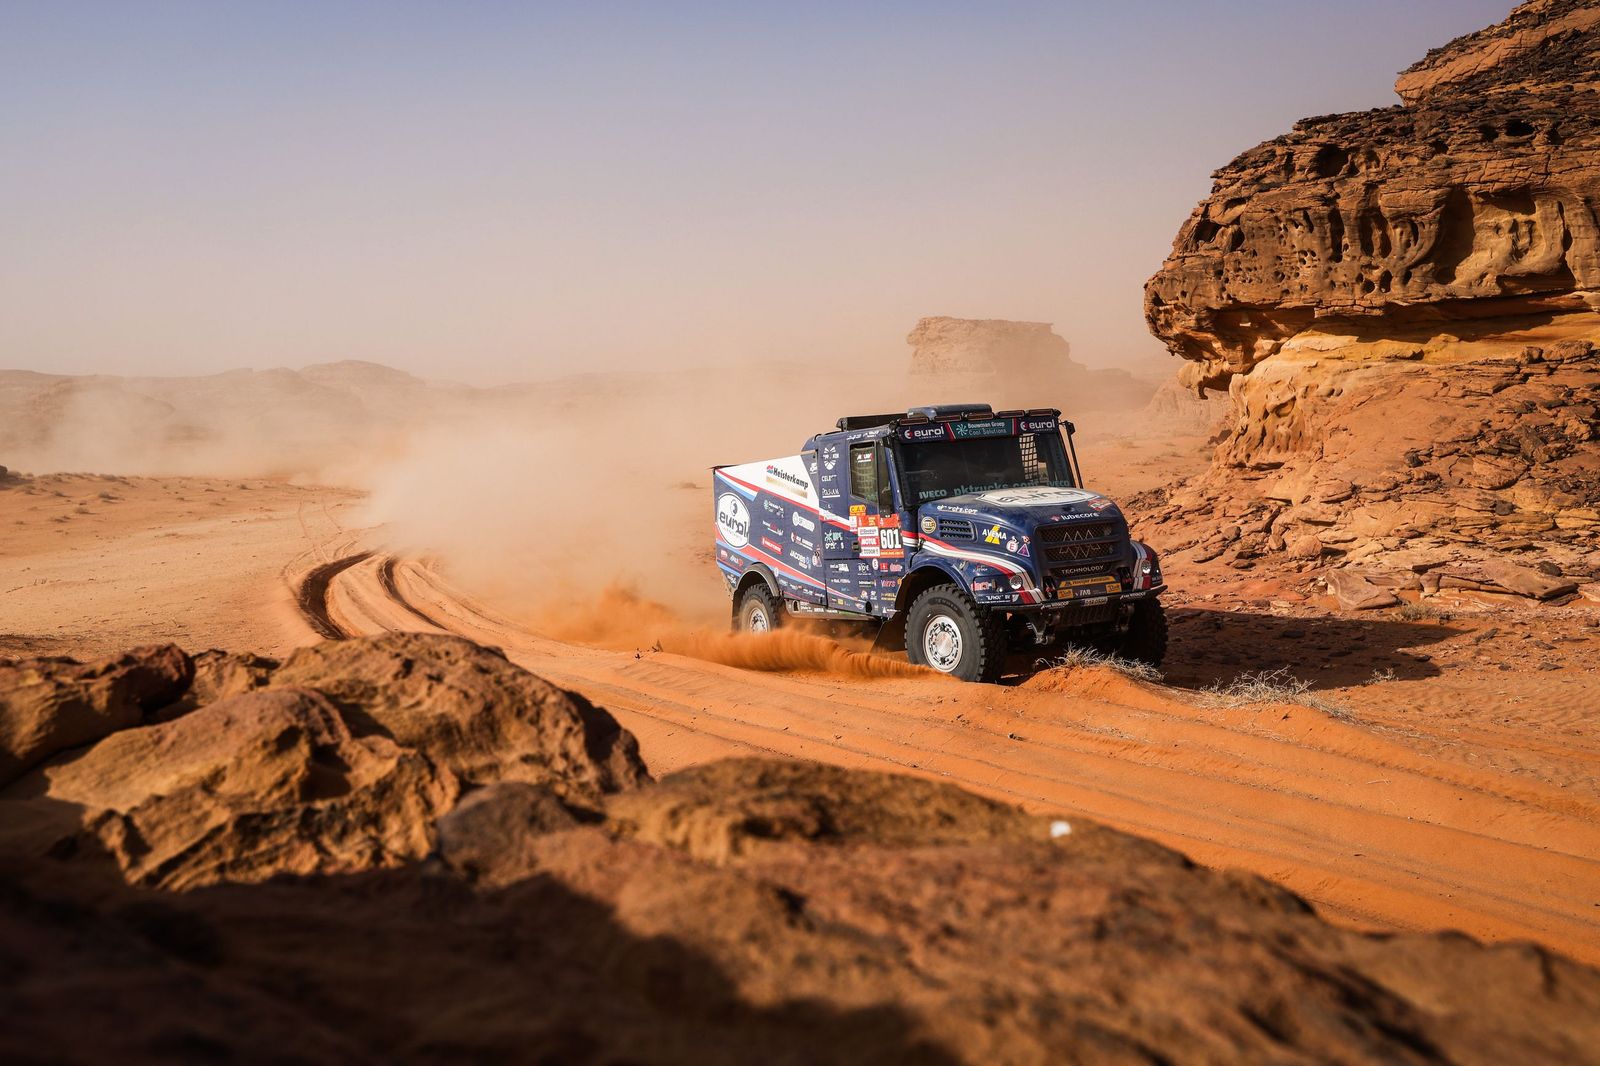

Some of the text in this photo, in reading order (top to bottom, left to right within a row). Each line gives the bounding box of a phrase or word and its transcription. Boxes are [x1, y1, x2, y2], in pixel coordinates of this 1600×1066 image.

[1029, 419, 1056, 429] eurol
[914, 427, 945, 438] eurol
[919, 488, 947, 499] IVECO
[1060, 512, 1100, 521] lubecore
[719, 511, 747, 537] eurol
[880, 528, 902, 549] 601
[981, 528, 1007, 540] AVEMA
[1061, 565, 1104, 575] TECHNOLOGY
